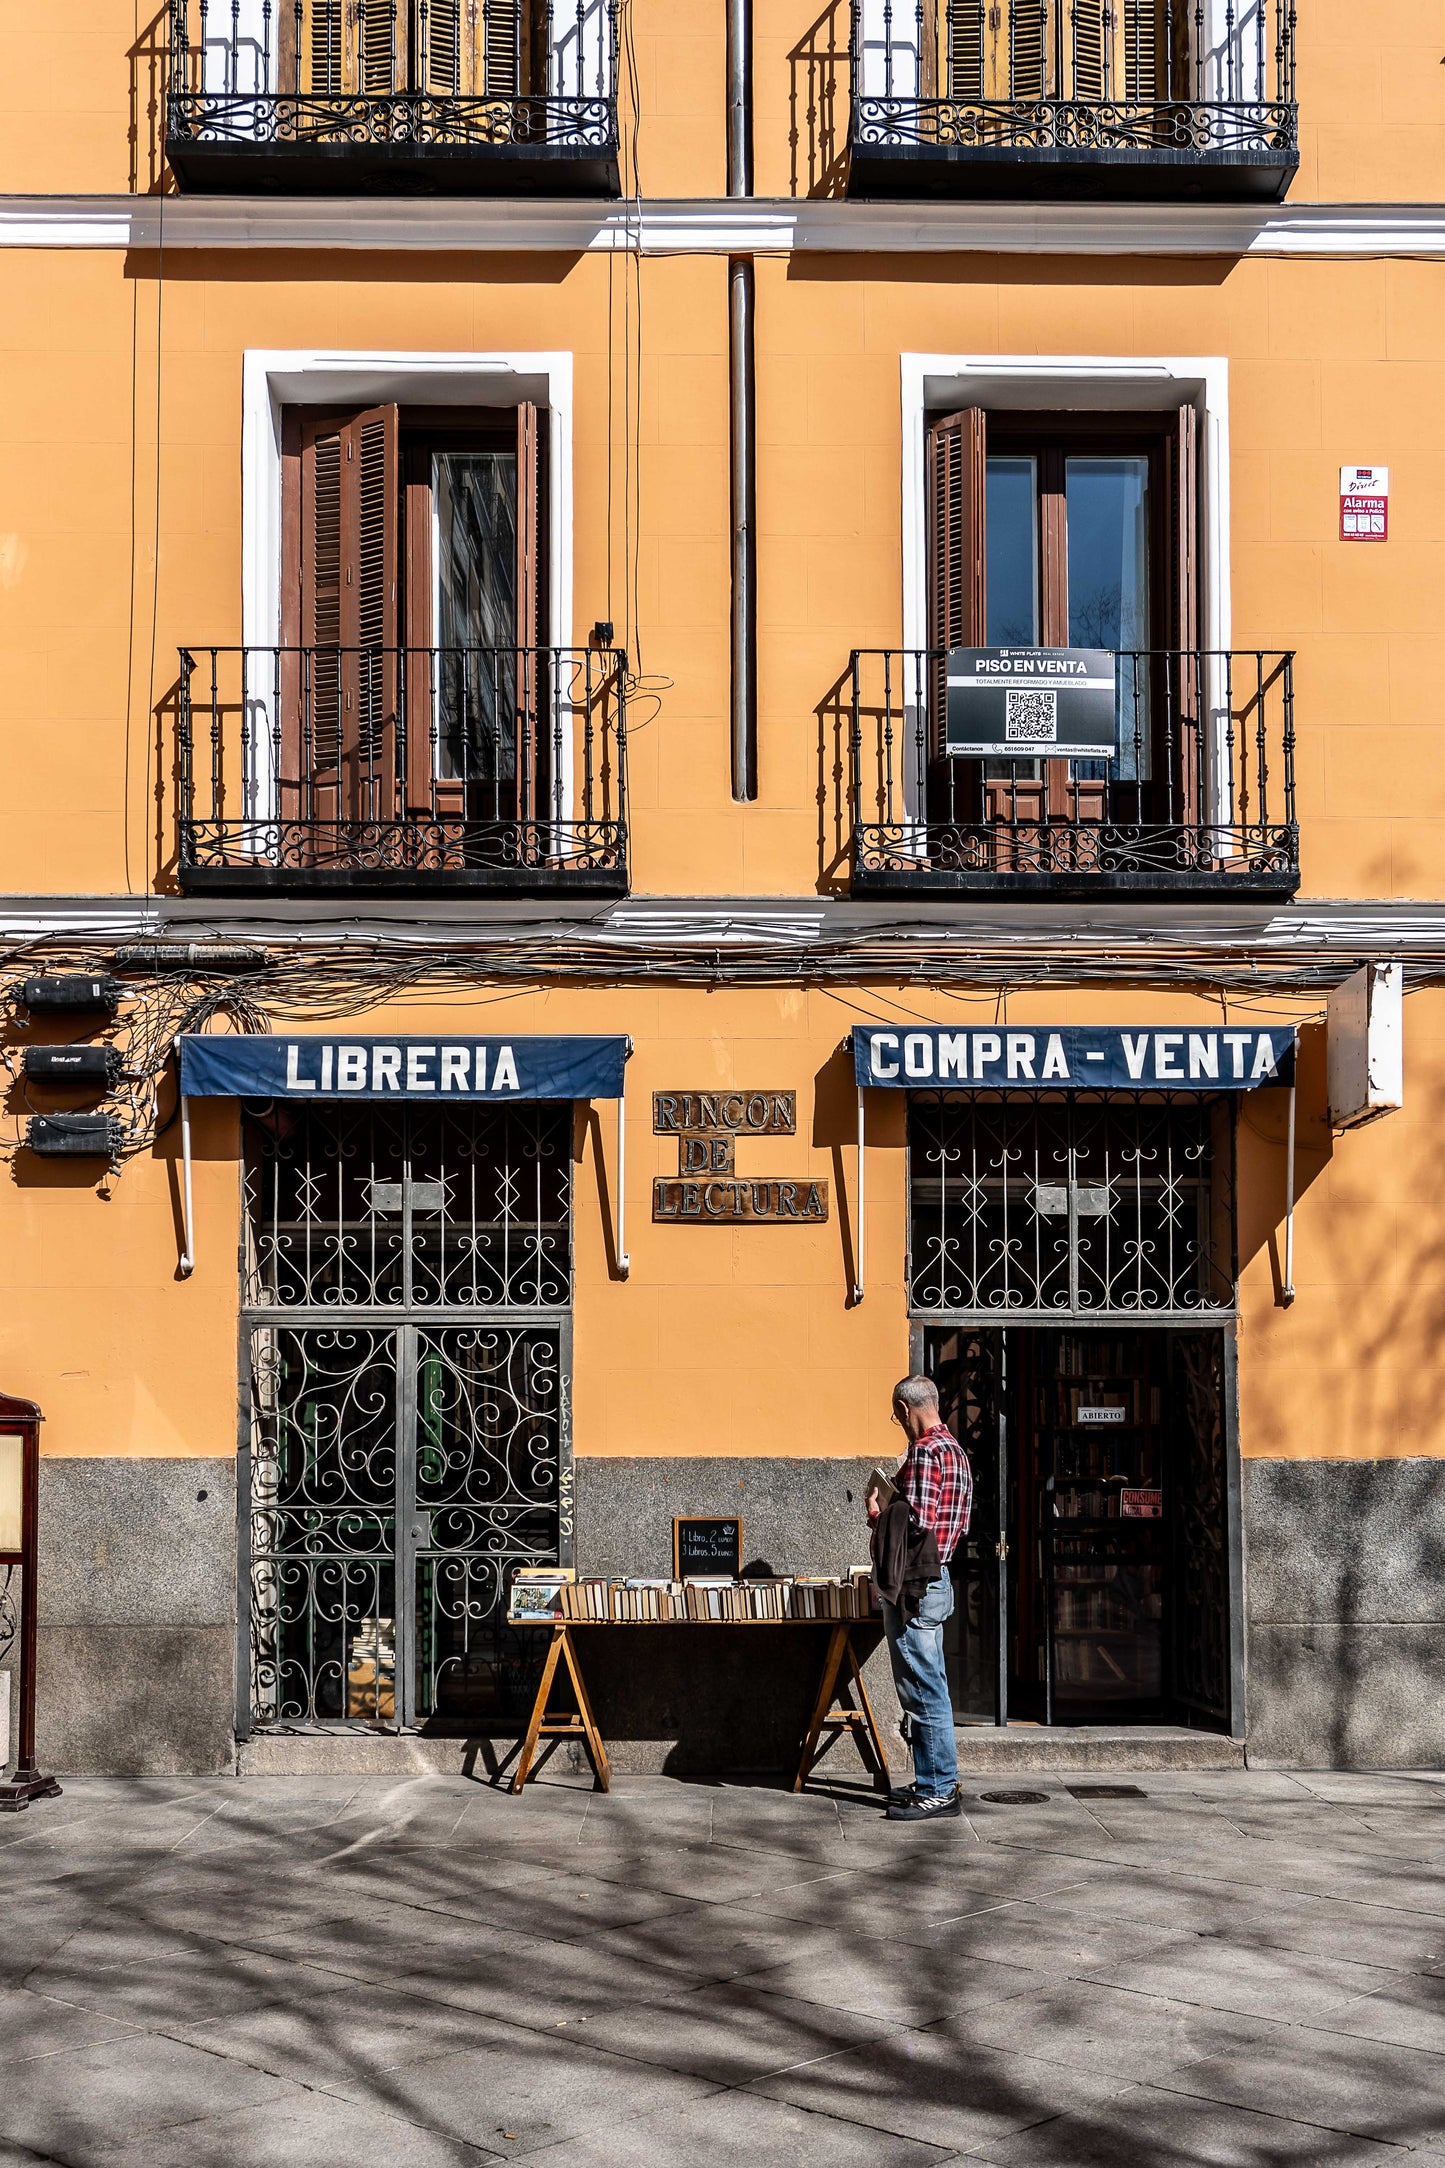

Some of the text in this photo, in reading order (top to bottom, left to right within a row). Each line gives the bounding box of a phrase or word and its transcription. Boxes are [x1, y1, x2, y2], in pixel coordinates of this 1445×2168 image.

[1343, 497, 1385, 508] Alarma
[975, 659, 1088, 674] PISO EN VENTA
[286, 1045, 520, 1091] LIBRERIA
[870, 1033, 1071, 1079] COMPRA
[1120, 1033, 1280, 1079] VENTA
[656, 1095, 794, 1129] RINCON
[684, 1138, 730, 1172] DE
[656, 1182, 827, 1216] LECTURA
[1082, 1412, 1121, 1420] ABIERTO
[682, 1528, 686, 1541] 1
[709, 1529, 717, 1543] 2
[682, 1544, 687, 1556] 3
[711, 1543, 718, 1557] 5
